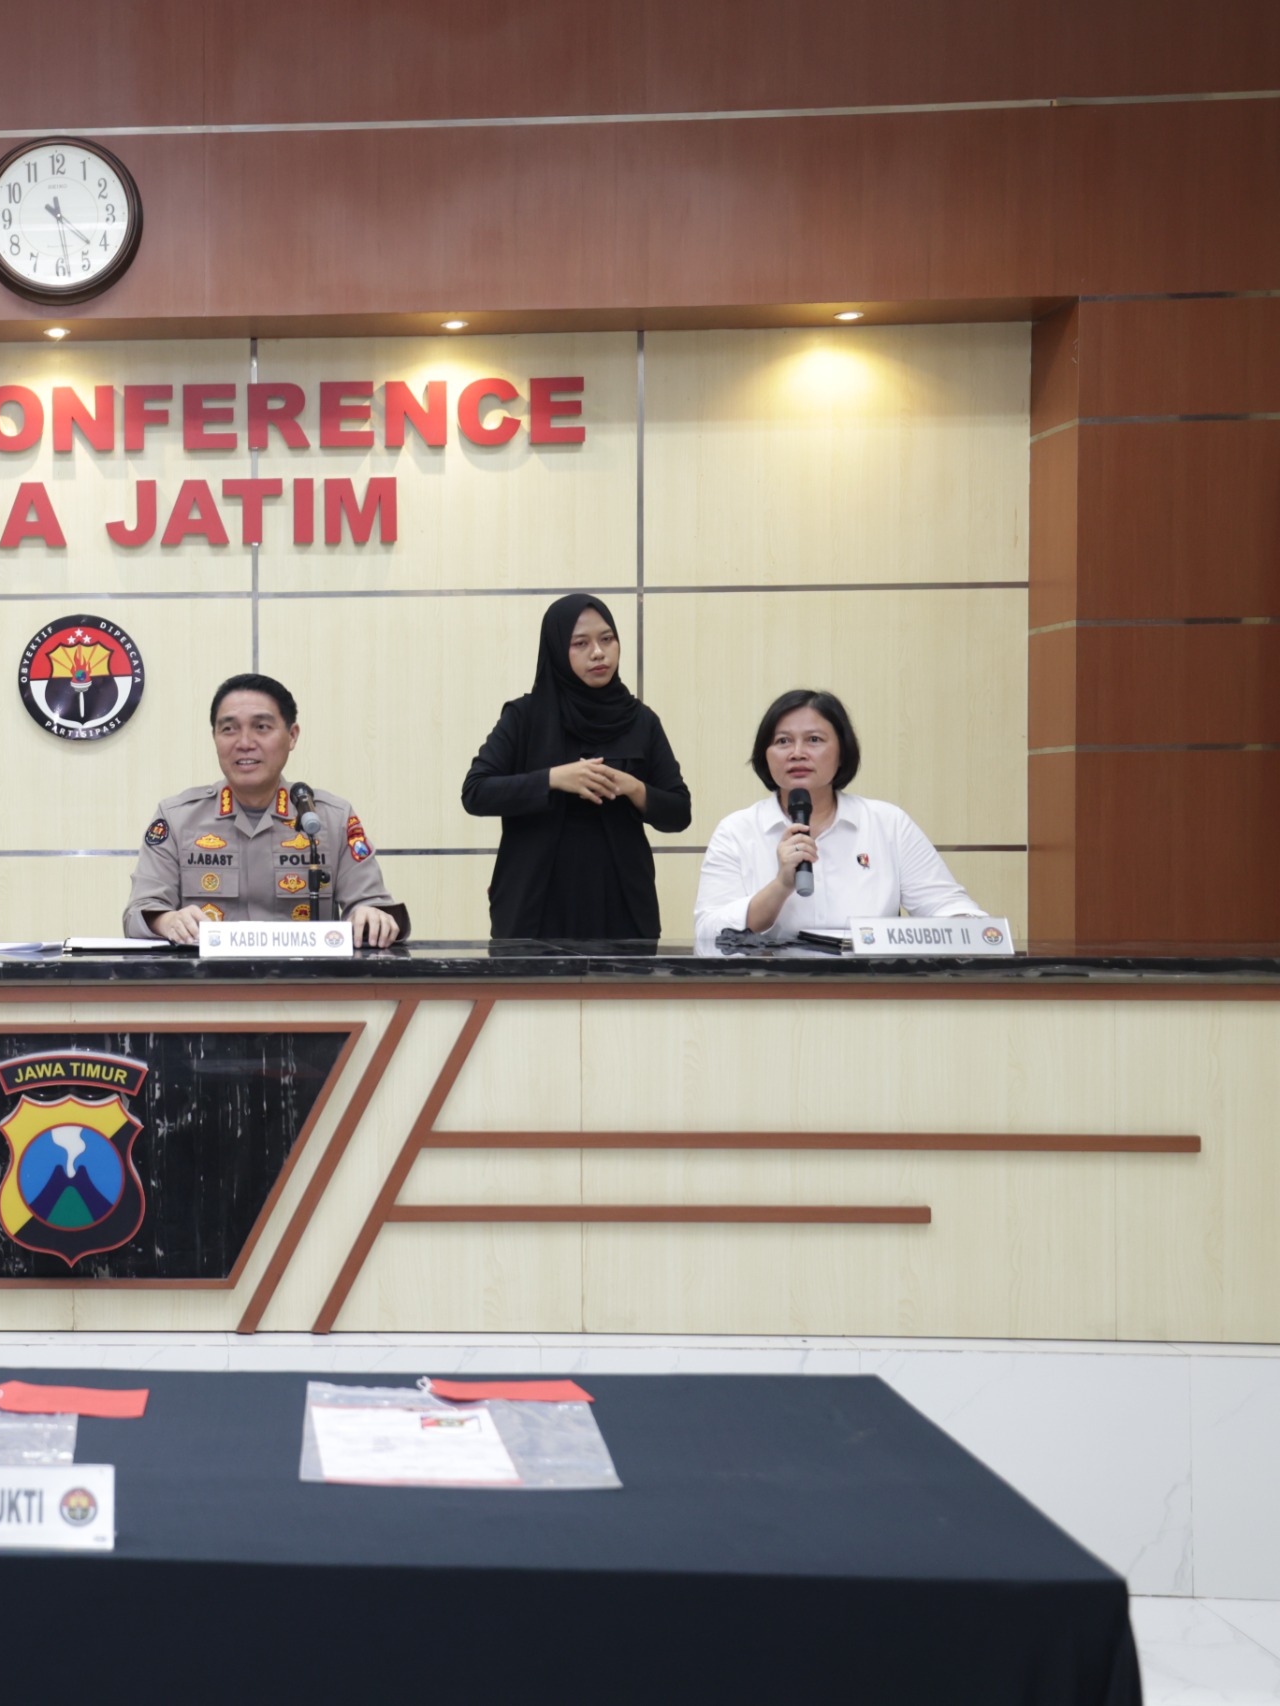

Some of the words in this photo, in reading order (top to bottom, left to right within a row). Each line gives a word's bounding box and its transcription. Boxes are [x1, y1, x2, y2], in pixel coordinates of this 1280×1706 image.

[25, 161, 38, 183] 11
[50, 153, 66, 175] 12
[6, 182, 22, 204] 10
[98, 178, 108, 200] 2
[2, 208, 12, 230] 9
[105, 204, 116, 224] 3
[10, 234, 20, 256] 8
[99, 230, 110, 252] 4
[29, 252, 39, 273] 7
[82, 250, 91, 272] 5
[105, 475, 398, 550] JATIM
[20, 626, 54, 683] OBYEKTIF
[99, 622, 142, 683] DIPERCAYA
[45, 717, 122, 738] PARTISIPASI
[230, 931, 268, 947] KABID
[272, 931, 317, 947] HUMAS
[887, 928, 954, 945] KASUBDIT
[14, 1062, 66, 1084] JAWA
[69, 1062, 129, 1085] TIMUR
